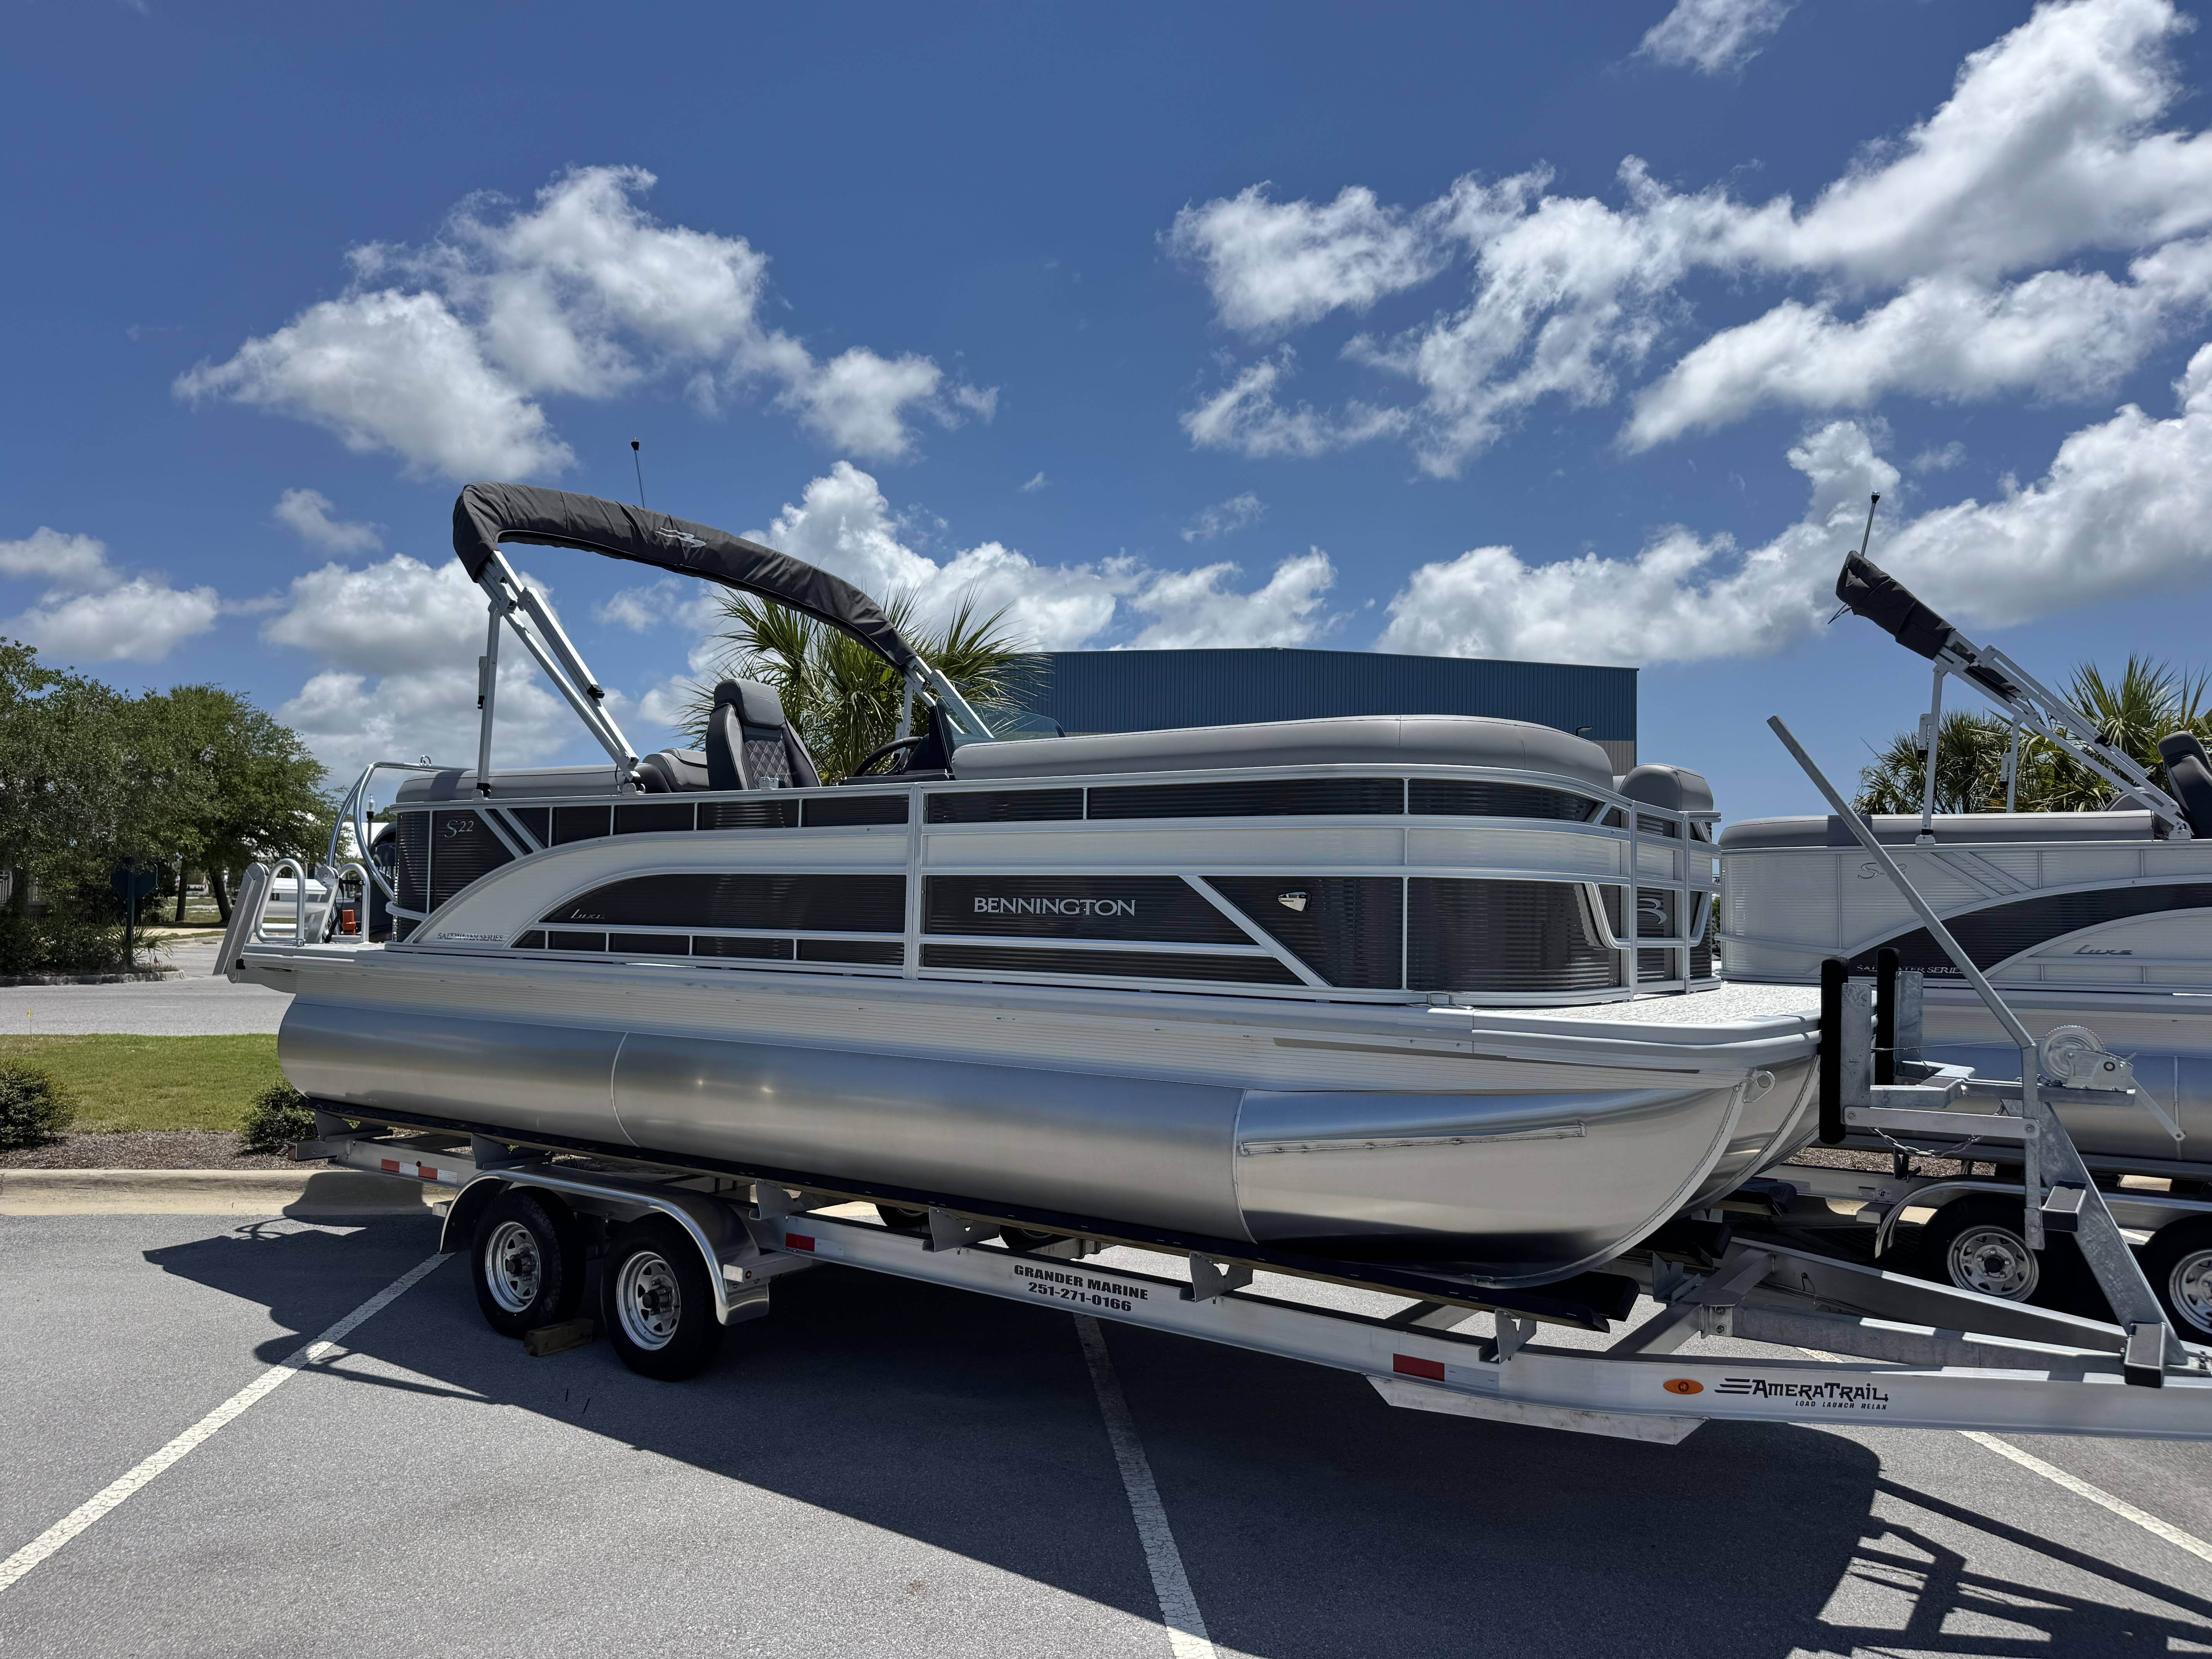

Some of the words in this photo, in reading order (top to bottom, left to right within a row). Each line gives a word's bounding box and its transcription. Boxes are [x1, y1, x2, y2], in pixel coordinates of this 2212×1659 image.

[444, 820, 474, 838] S22
[1858, 862, 1906, 879] S2
[974, 897, 1136, 917] BENNINGTON
[437, 933, 479, 941] SALTWATER
[1014, 1264, 1083, 1287] GRANDER
[1087, 1278, 1148, 1300] MARINE
[1028, 1282, 1132, 1311] 251-271-0166
